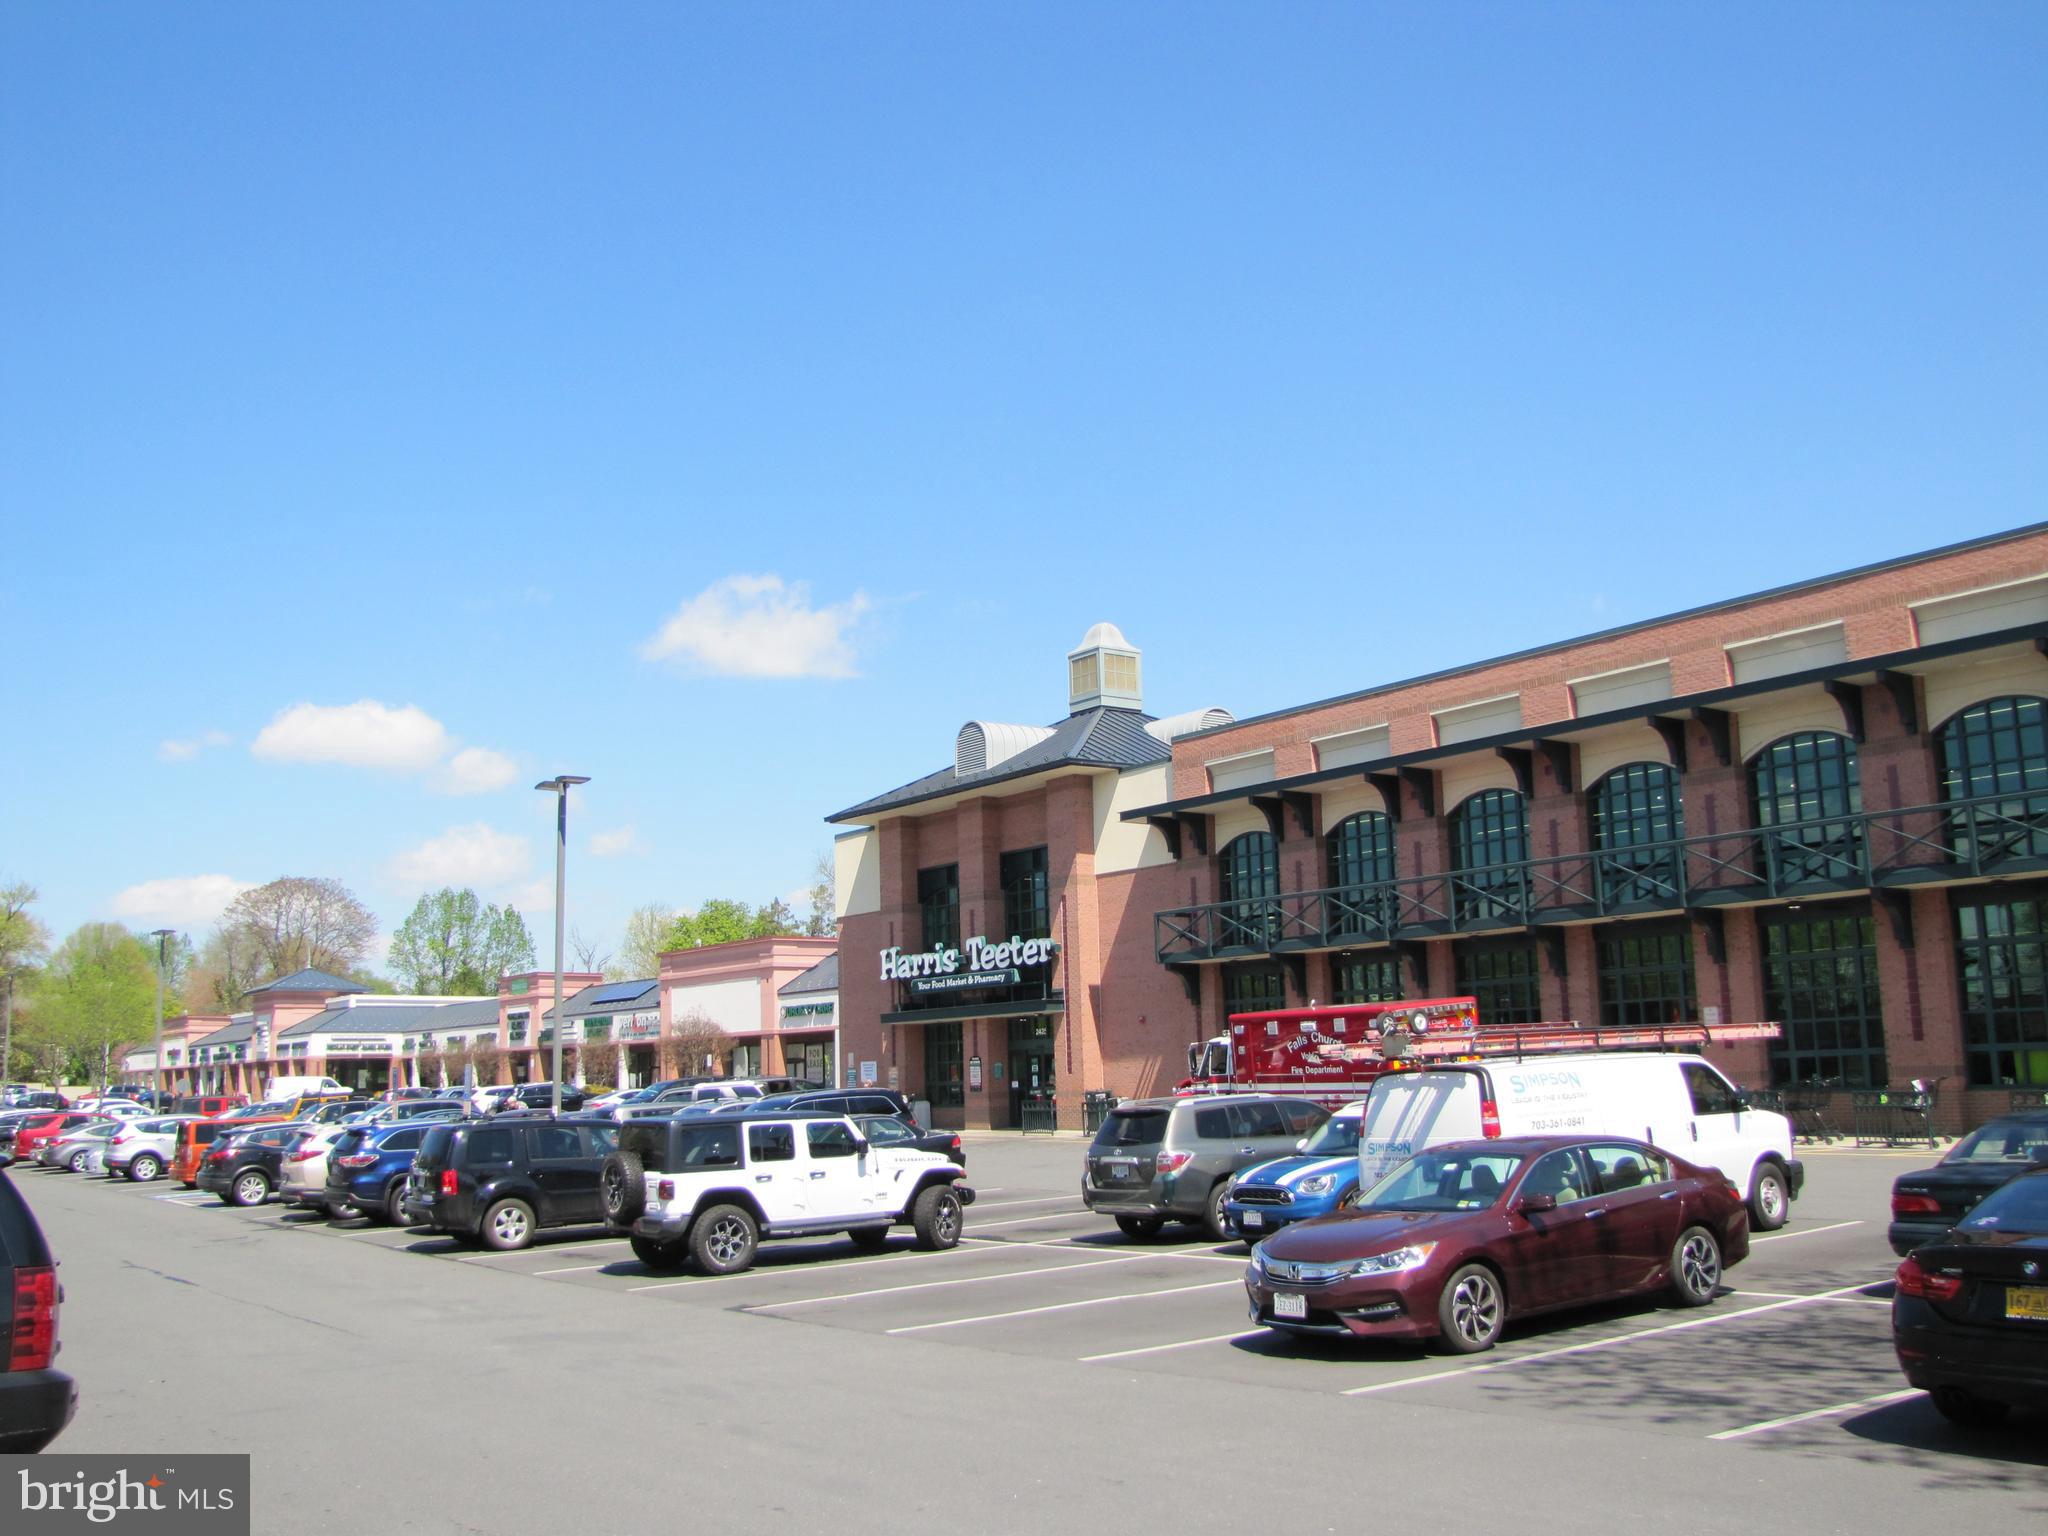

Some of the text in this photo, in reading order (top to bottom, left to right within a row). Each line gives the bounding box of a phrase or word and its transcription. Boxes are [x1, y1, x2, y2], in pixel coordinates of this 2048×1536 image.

[880, 935, 1056, 980] Harris Teeter
[918, 974, 1006, 990] Your Food Market & Pharmacy
[1286, 1035, 1308, 1054] Falls
[1291, 1065, 1344, 1075] Fire Department
[1509, 1072, 1582, 1094] SIMPSON
[1368, 1142, 1411, 1155] SIMPSON
